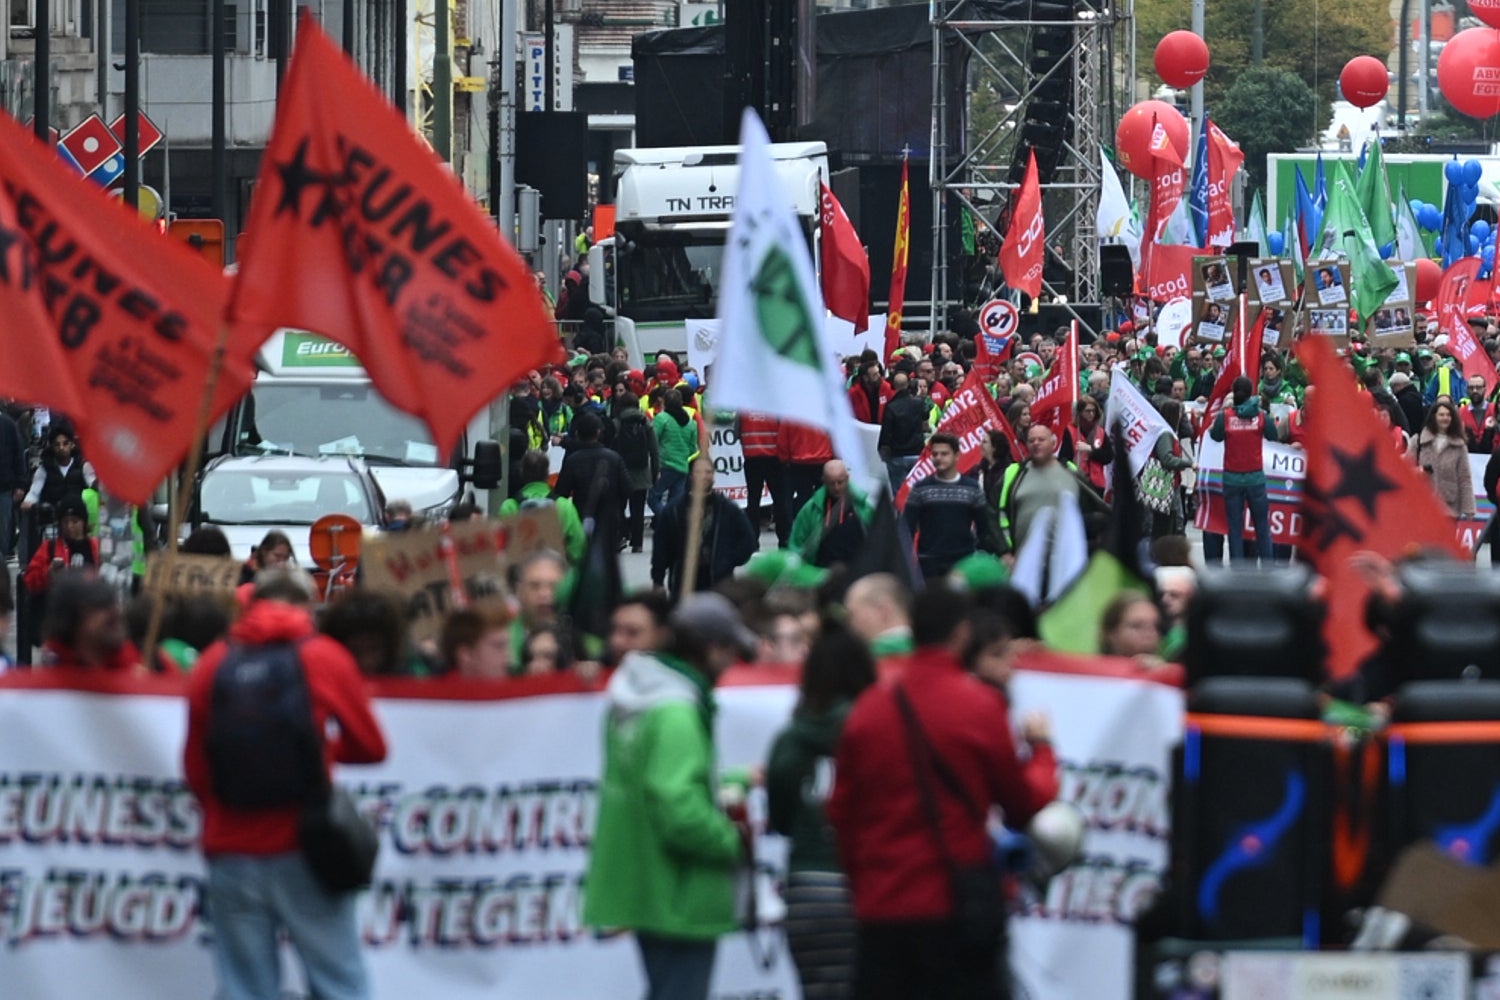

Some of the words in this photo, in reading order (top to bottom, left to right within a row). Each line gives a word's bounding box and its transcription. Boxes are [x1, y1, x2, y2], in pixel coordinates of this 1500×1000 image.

[665, 198, 691, 212] TN
[697, 195, 735, 210] TRA
[1150, 274, 1187, 298] acod
[986, 312, 1011, 328] 67
[0, 774, 203, 851] EUNESS
[393, 778, 600, 855] CONTR
